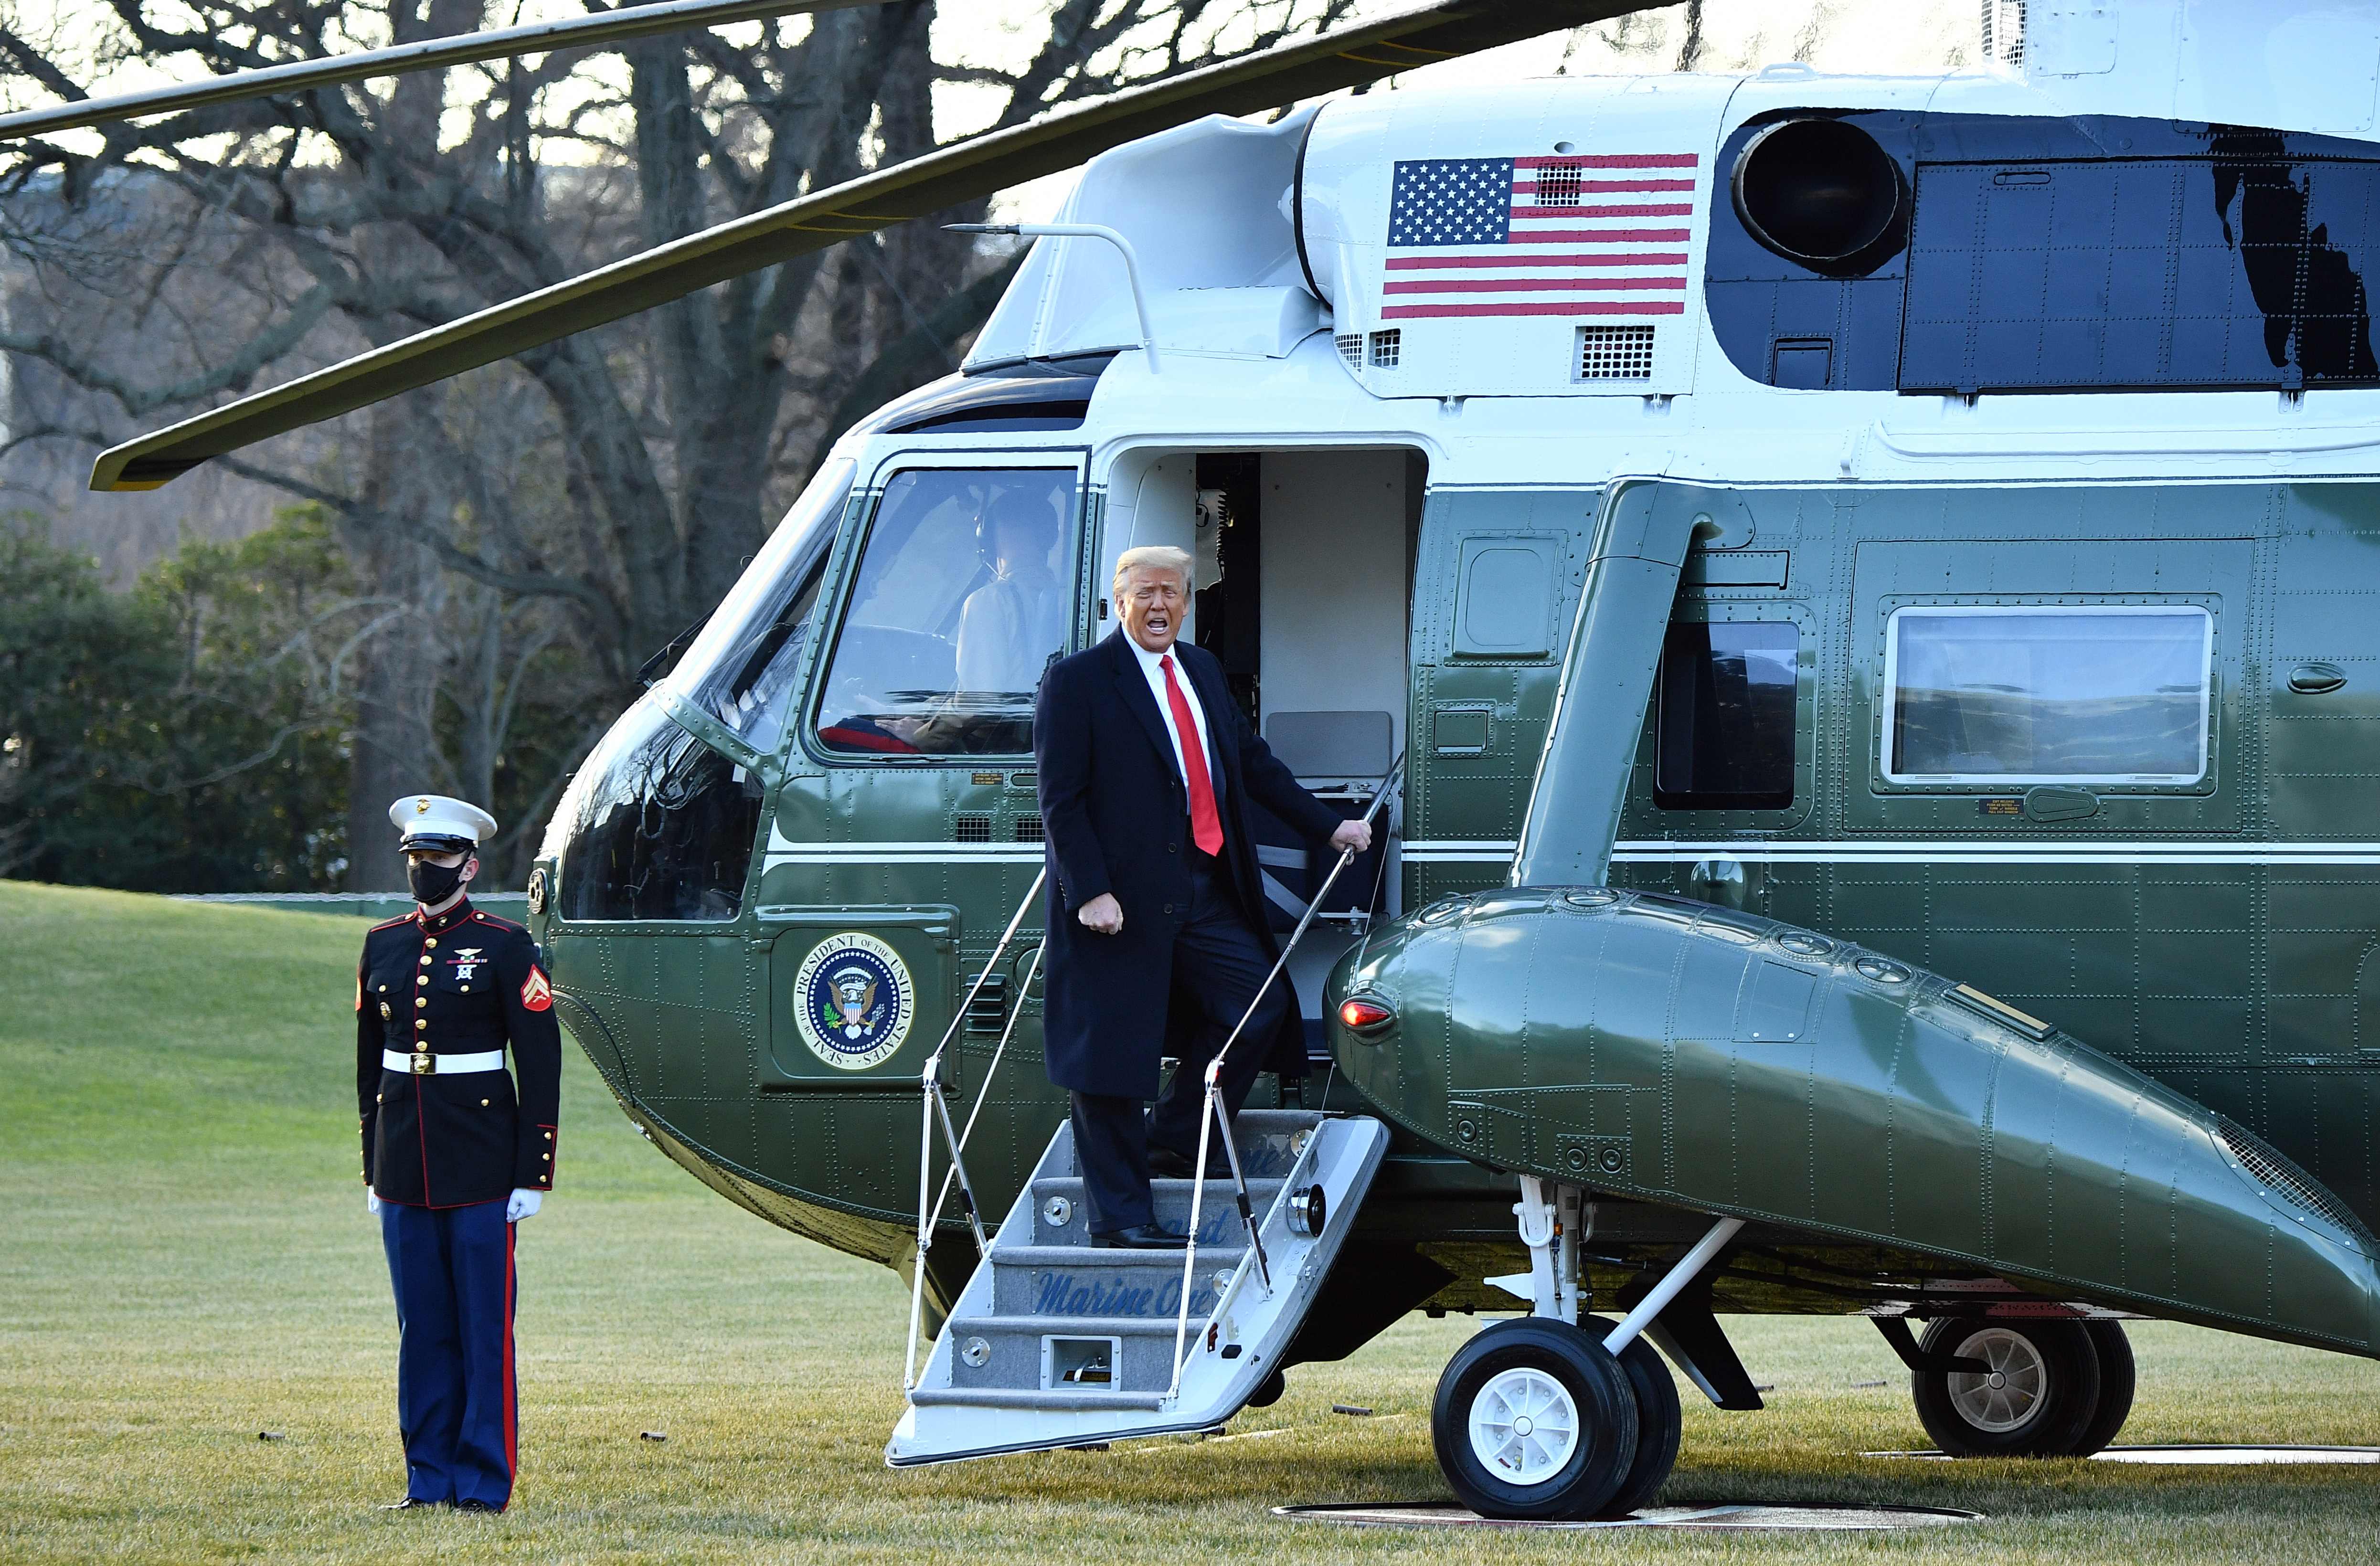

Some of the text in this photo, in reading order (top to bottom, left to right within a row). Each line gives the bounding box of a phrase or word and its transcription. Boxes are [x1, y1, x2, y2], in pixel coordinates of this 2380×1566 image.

[861, 939, 873, 948] OF
[874, 943, 890, 960] THE
[797, 935, 856, 995] PRESIDENT
[890, 958, 912, 1019] UNITED
[798, 1003, 807, 1023] THE
[803, 1025, 812, 1036] OF
[863, 1023, 906, 1065] STATES
[813, 1036, 843, 1065] SEAL
[1035, 1272, 1154, 1315] Marine
